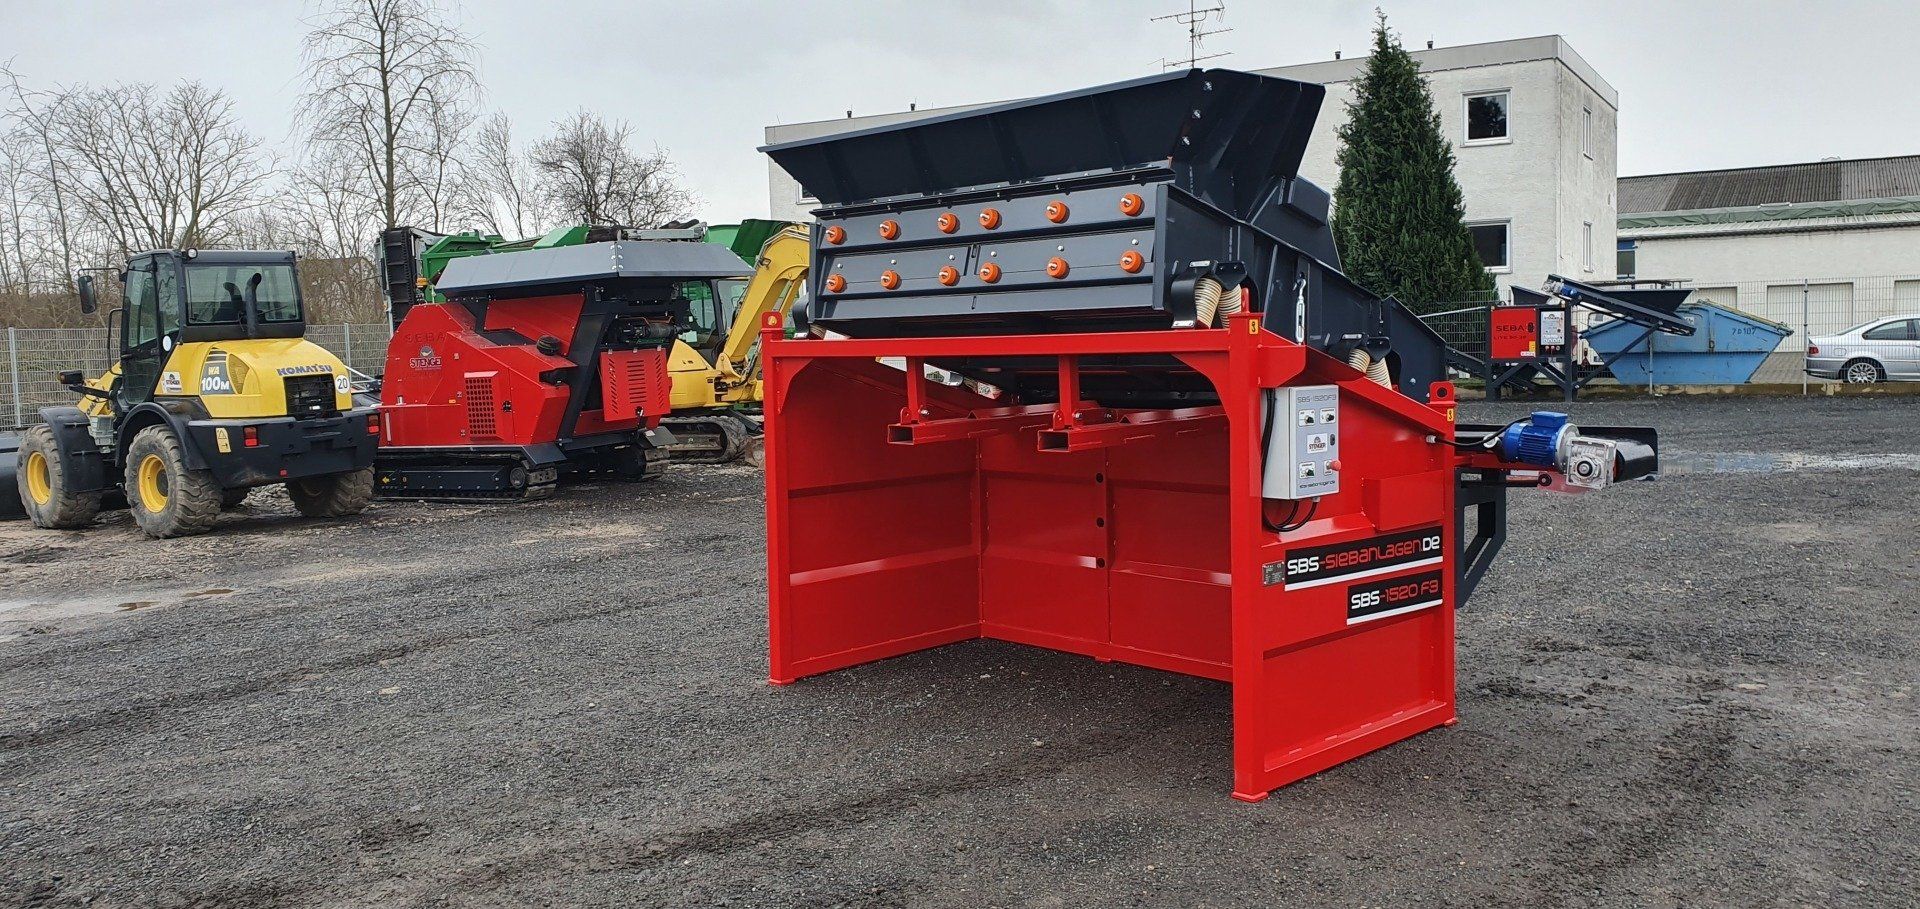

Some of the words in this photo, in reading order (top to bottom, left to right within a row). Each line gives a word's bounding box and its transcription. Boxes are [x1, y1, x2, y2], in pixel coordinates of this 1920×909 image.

[1495, 324, 1524, 332] SEBA
[208, 366, 220, 375] WA
[276, 364, 333, 376] KOMATSU
[201, 376, 230, 391] 100M
[337, 377, 348, 390] 20
[1350, 583, 1419, 610] SBS-1520
[1420, 579, 1439, 596] F3
